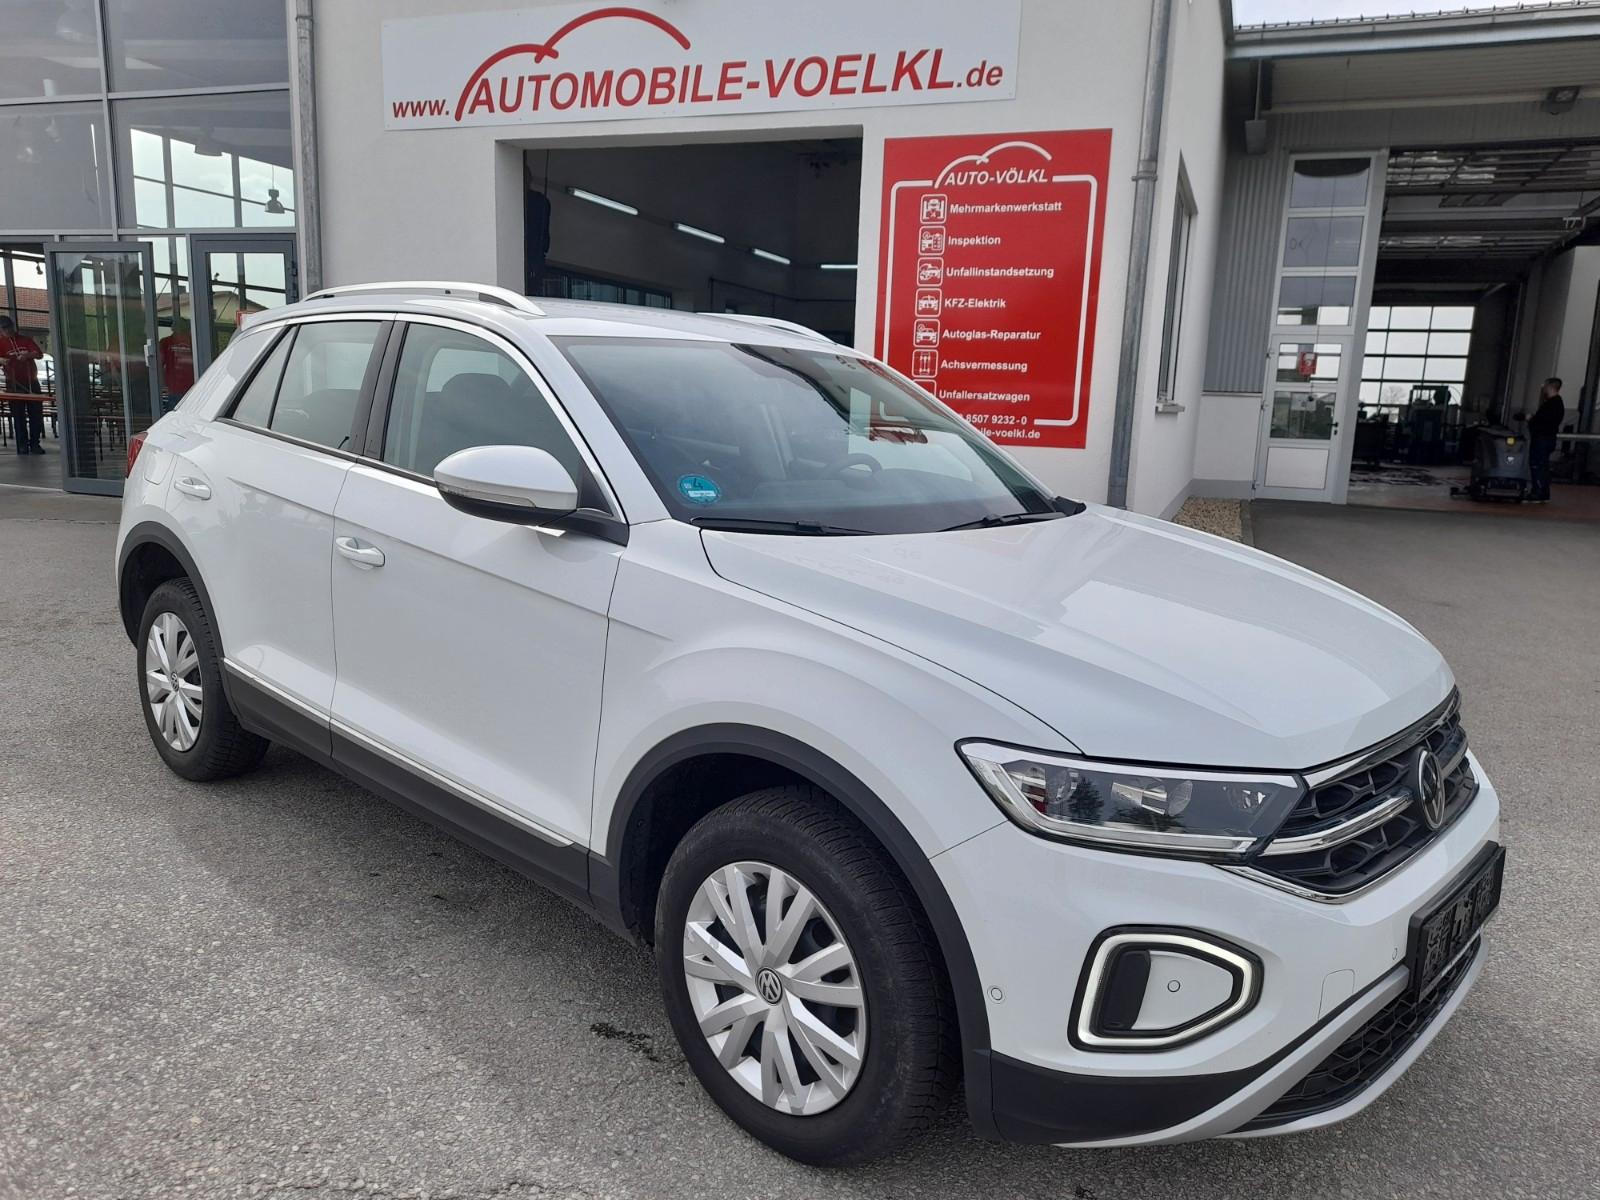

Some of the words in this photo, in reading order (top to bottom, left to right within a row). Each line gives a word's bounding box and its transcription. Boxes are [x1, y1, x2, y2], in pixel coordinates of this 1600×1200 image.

[944, 167, 1048, 185] AUTO-VÖLKL
[950, 202, 1062, 213] Mehrmarkenwerkstatt
[948, 236, 1001, 246] Inspektion
[946, 267, 1054, 278] Unfallinstandsetzung
[944, 298, 1006, 308] KFZ-Elektrik
[942, 329, 1041, 341] Autoglas-Reparatur
[940, 359, 1028, 373] Achsvermessung
[939, 389, 1030, 402] Unfallersatzwagen
[966, 413, 990, 424] 8507
[980, 427, 1041, 439] ile-voelkl.de
